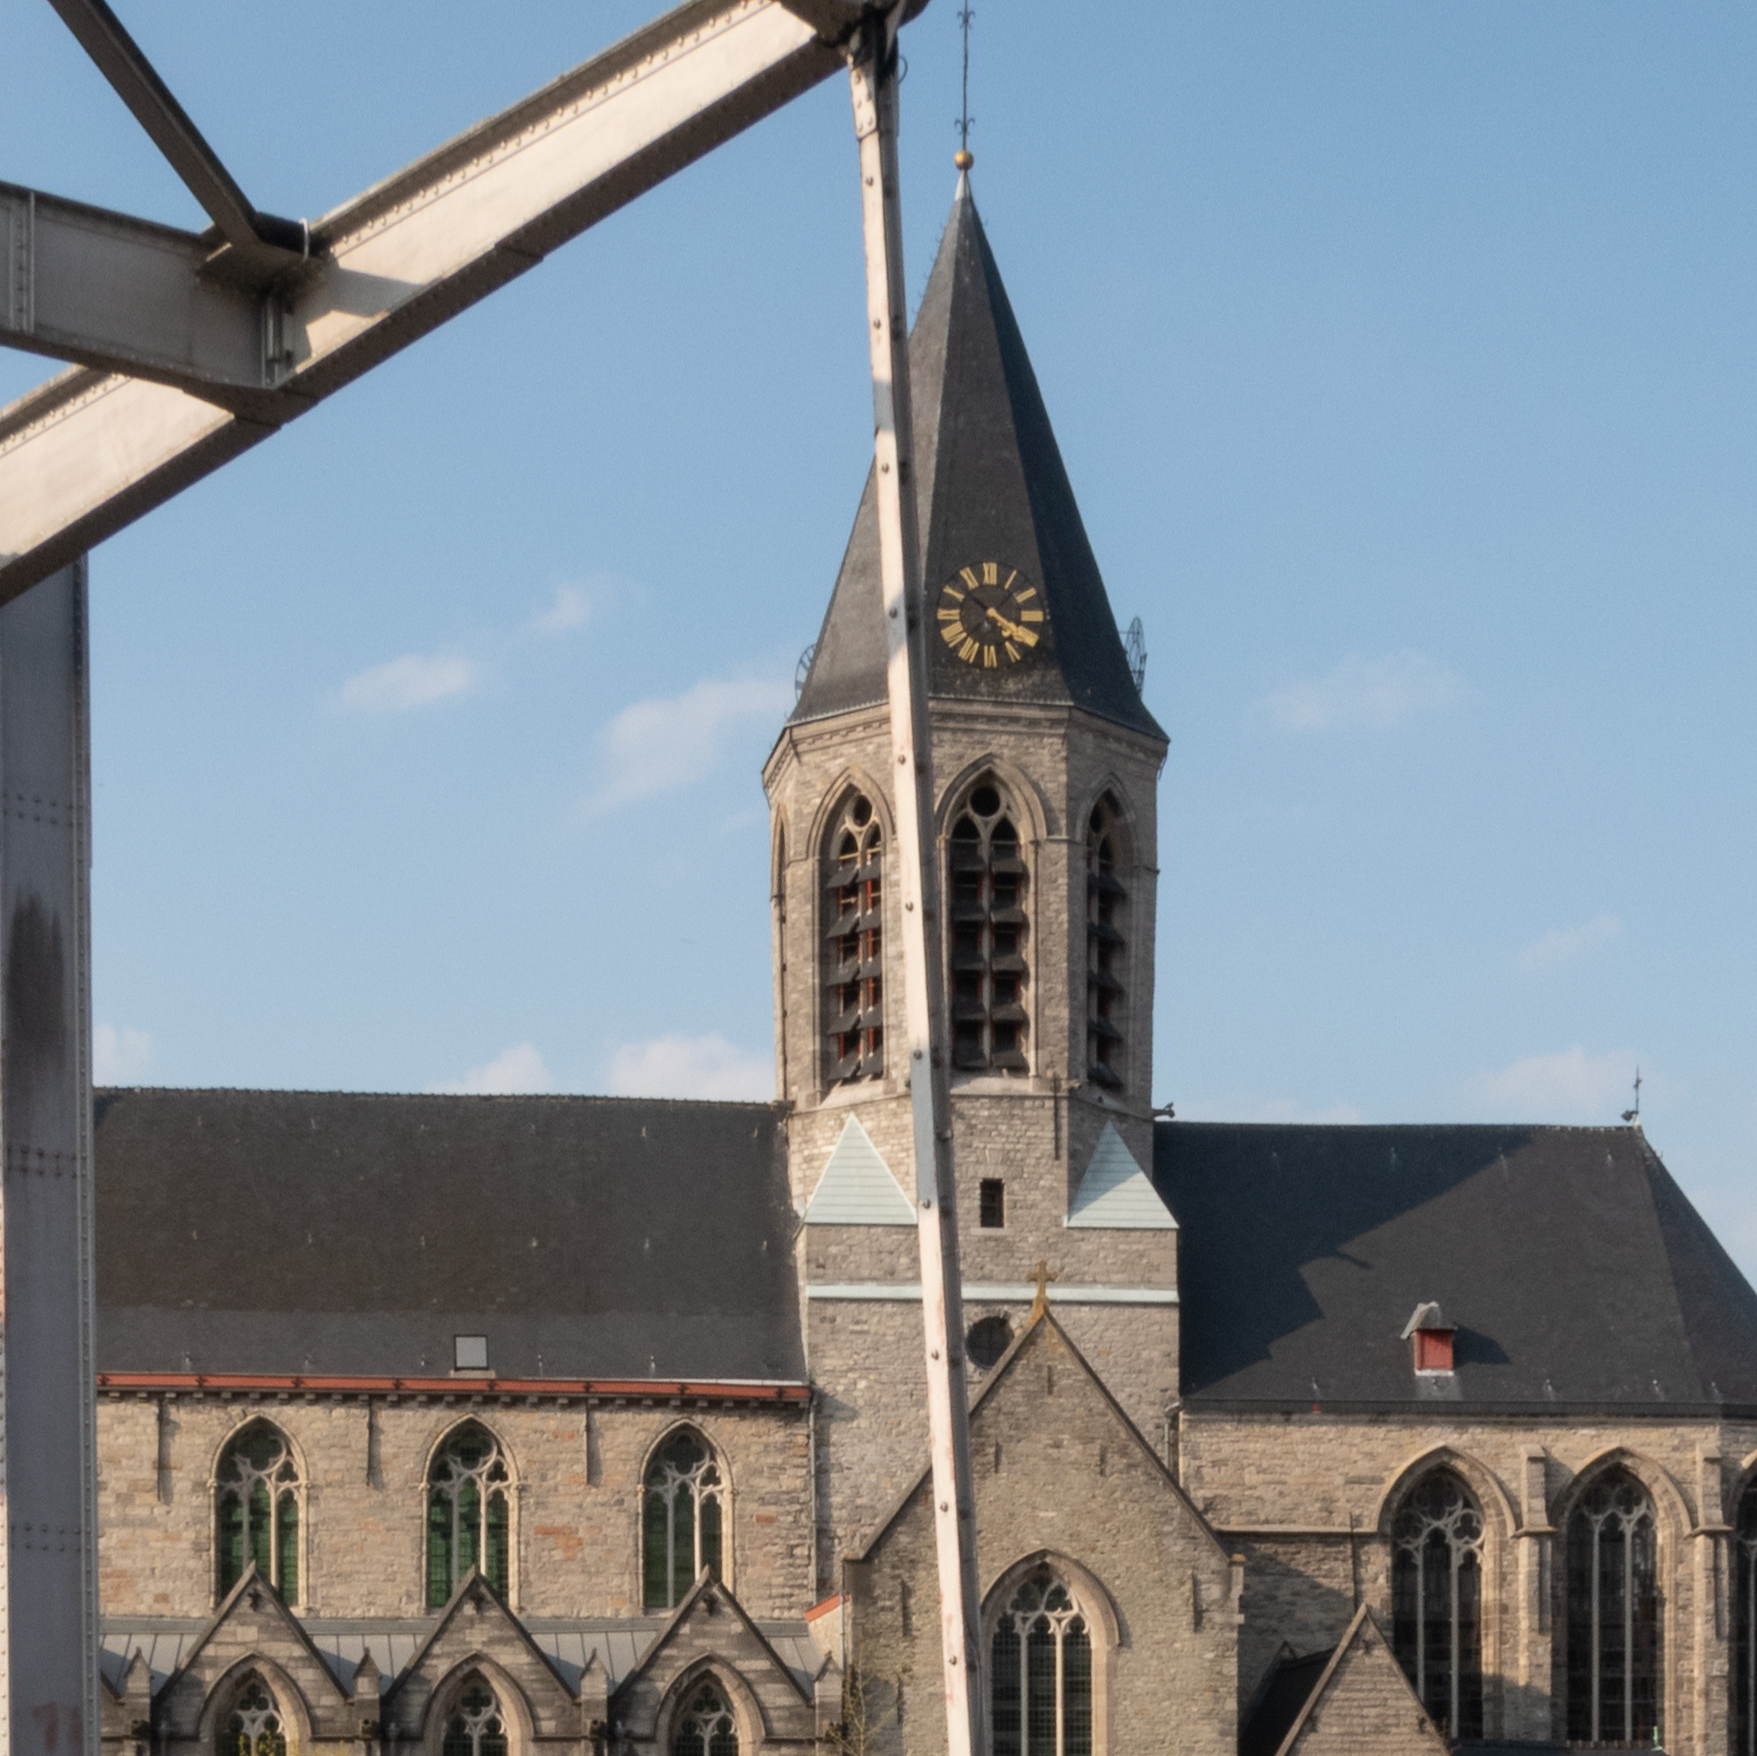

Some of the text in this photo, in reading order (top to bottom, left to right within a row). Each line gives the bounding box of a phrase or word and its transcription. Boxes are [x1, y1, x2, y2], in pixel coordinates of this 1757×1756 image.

[1004, 569, 1017, 590] I
[943, 585, 965, 602] X
[1015, 587, 1037, 603] II
[937, 608, 960, 620] IX
[1021, 610, 1044, 622] III
